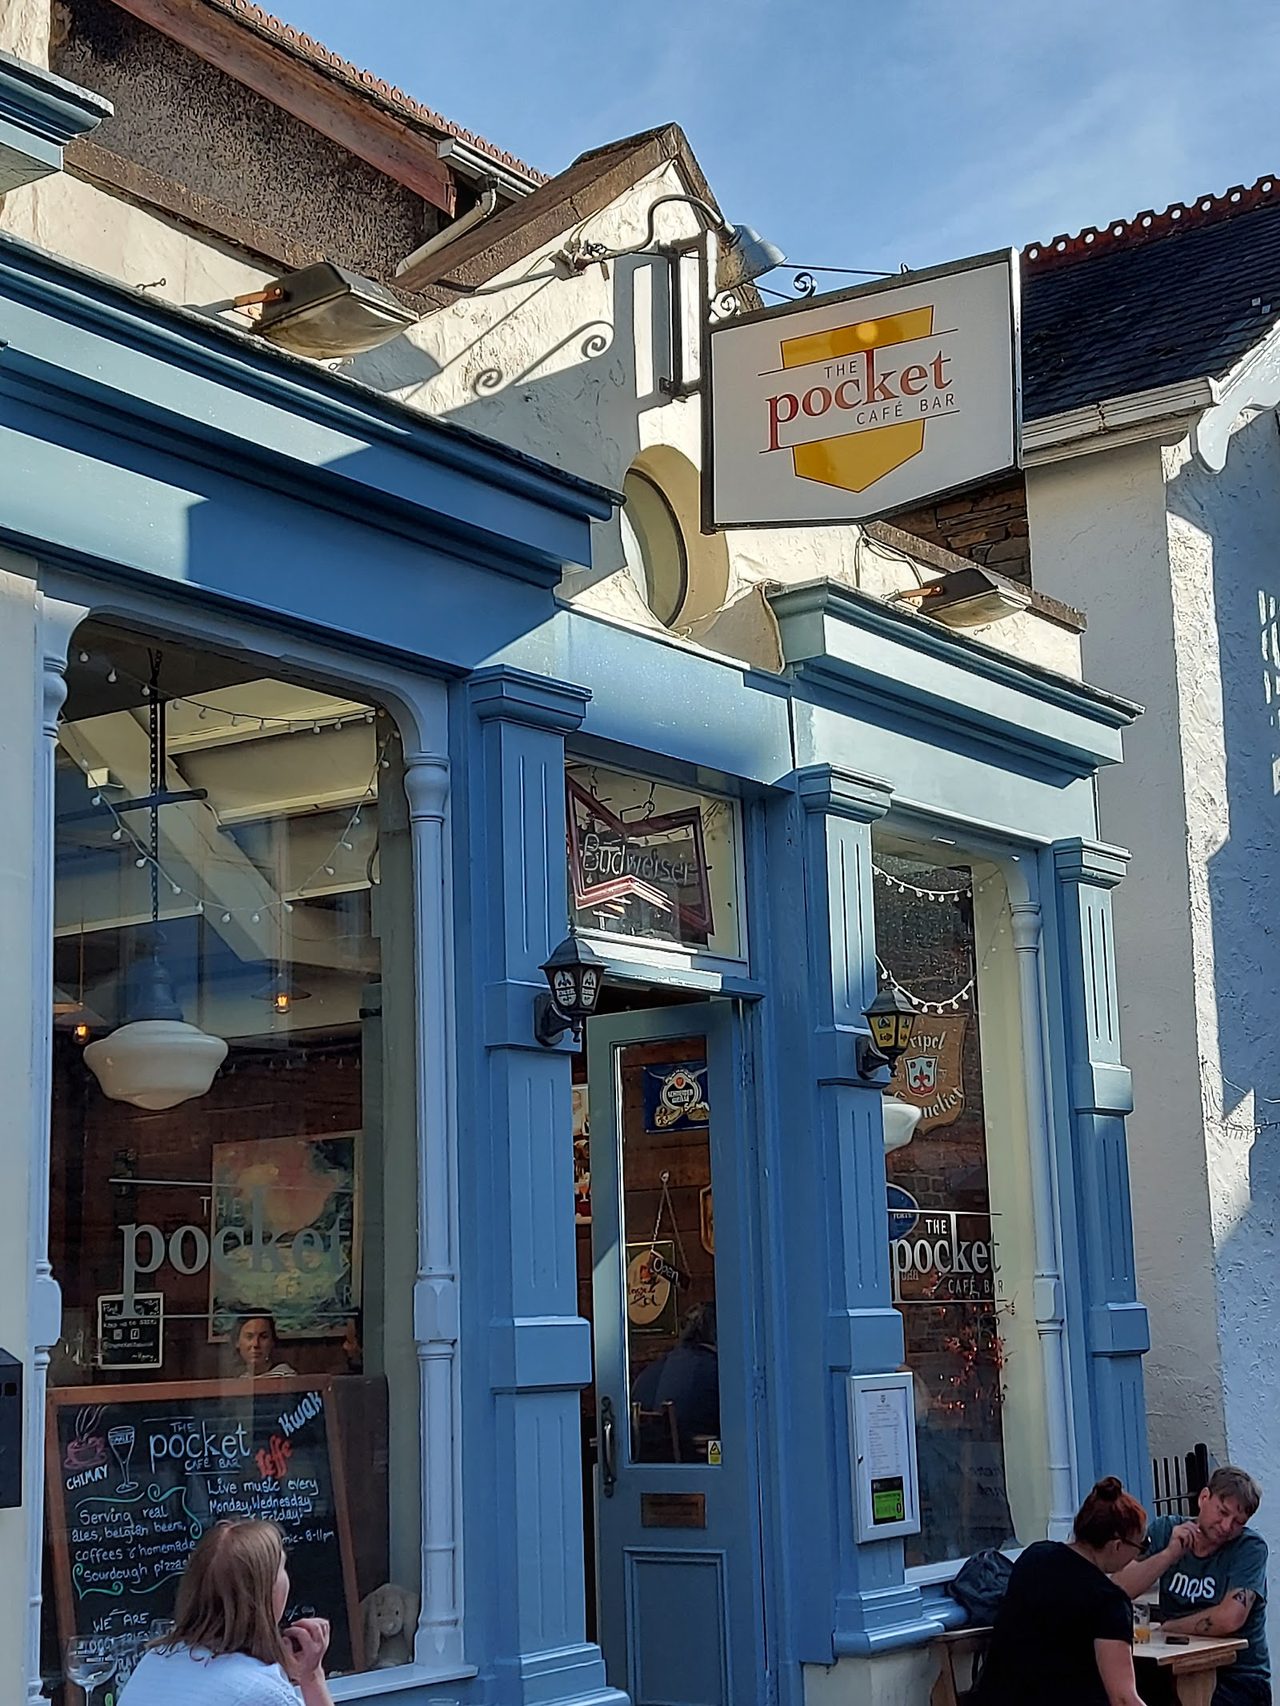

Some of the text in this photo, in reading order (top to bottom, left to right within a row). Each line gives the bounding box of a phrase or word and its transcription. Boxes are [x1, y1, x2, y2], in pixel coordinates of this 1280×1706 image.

[824, 361, 857, 379] THE
[765, 349, 953, 451] pocket
[857, 393, 954, 425] CAFÉ BAR
[583, 833, 696, 885] Budweiser
[910, 1031, 947, 1052] ripel
[926, 1219, 948, 1235] THE
[118, 1185, 351, 1319] pocket
[890, 1213, 1002, 1303] pocket
[653, 1257, 680, 1284] Open
[169, 1422, 196, 1433] THE
[150, 1420, 251, 1474] pocket
[218, 1459, 242, 1469] BAR
[66, 1464, 110, 1490] CHIMAY
[207, 1476, 319, 1496] Live music every
[252, 1494, 312, 1513] Wednesday
[79, 1505, 168, 1529] Serving real
[104, 1524, 149, 1544] belgian
[75, 1547, 123, 1564] coffees
[138, 1537, 197, 1556] homemade
[93, 1612, 150, 1634] WE ARE
